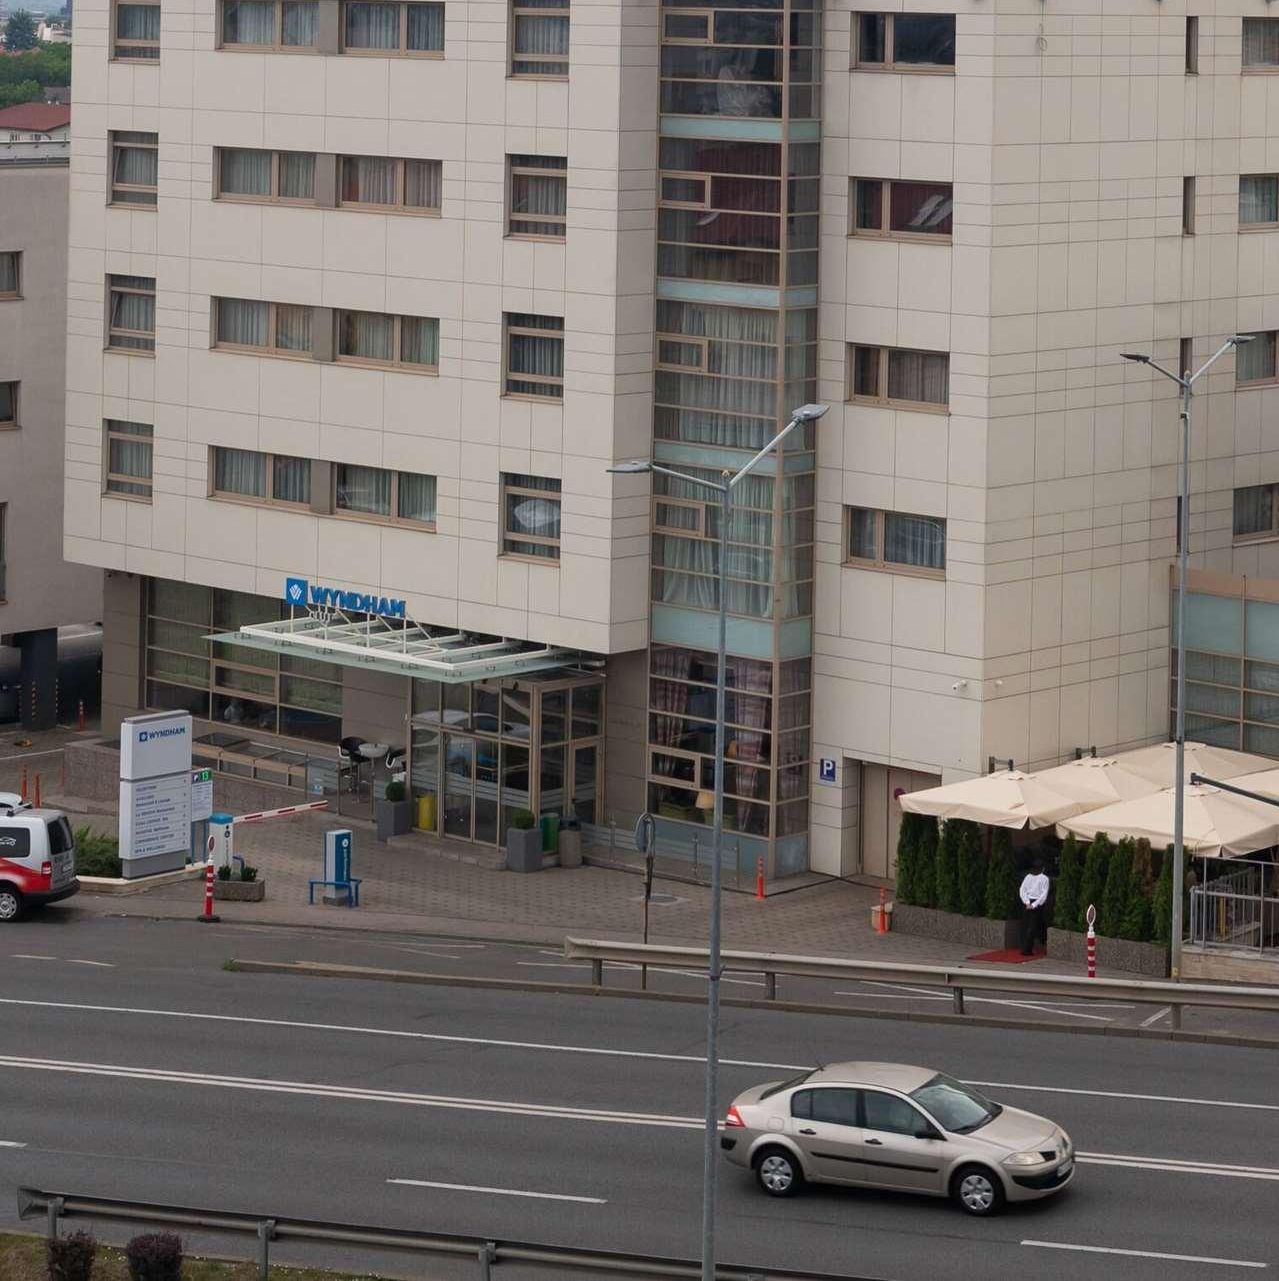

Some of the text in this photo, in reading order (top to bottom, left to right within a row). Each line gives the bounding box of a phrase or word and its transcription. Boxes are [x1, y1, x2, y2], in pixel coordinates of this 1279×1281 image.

[310, 585, 407, 618] WYNDHAM
[149, 726, 186, 739] WYNDHAM
[823, 760, 833, 775] P
